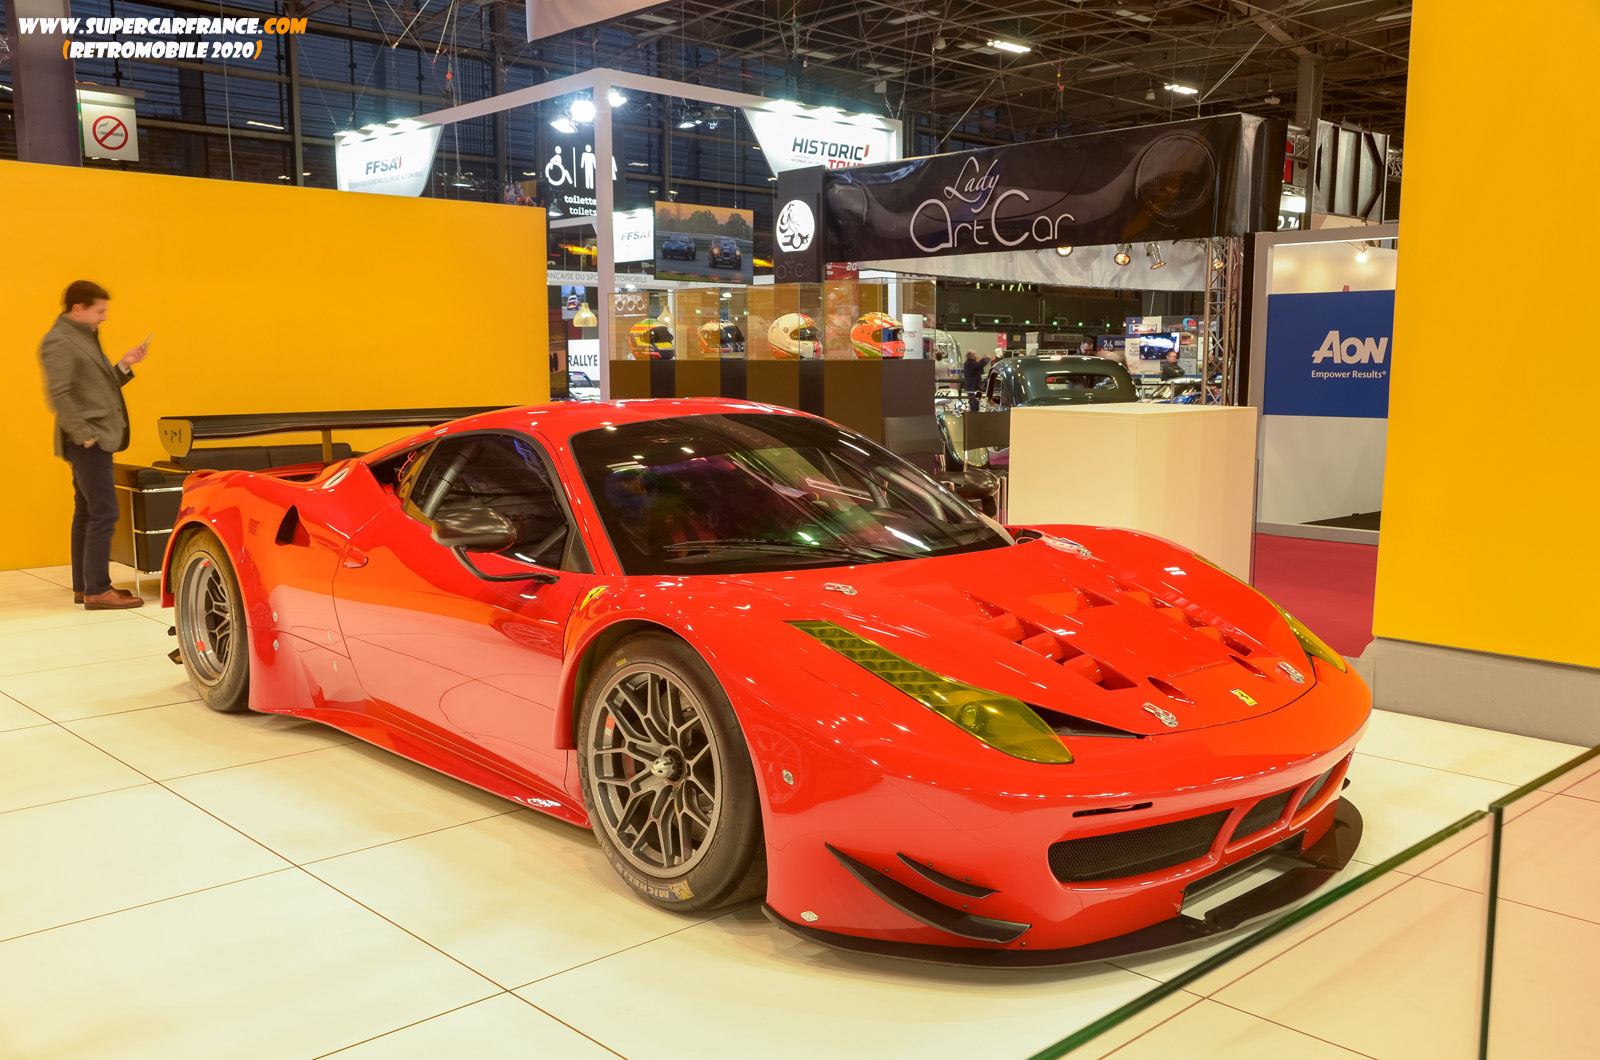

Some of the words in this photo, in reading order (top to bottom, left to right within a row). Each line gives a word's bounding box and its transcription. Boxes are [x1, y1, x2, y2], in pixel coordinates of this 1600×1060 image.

[944, 156, 999, 213] Lady
[569, 207, 597, 217] toilets
[568, 354, 598, 367] RALLYE
[1311, 370, 1350, 380] Empower
[615, 863, 670, 899] MICHELIN
